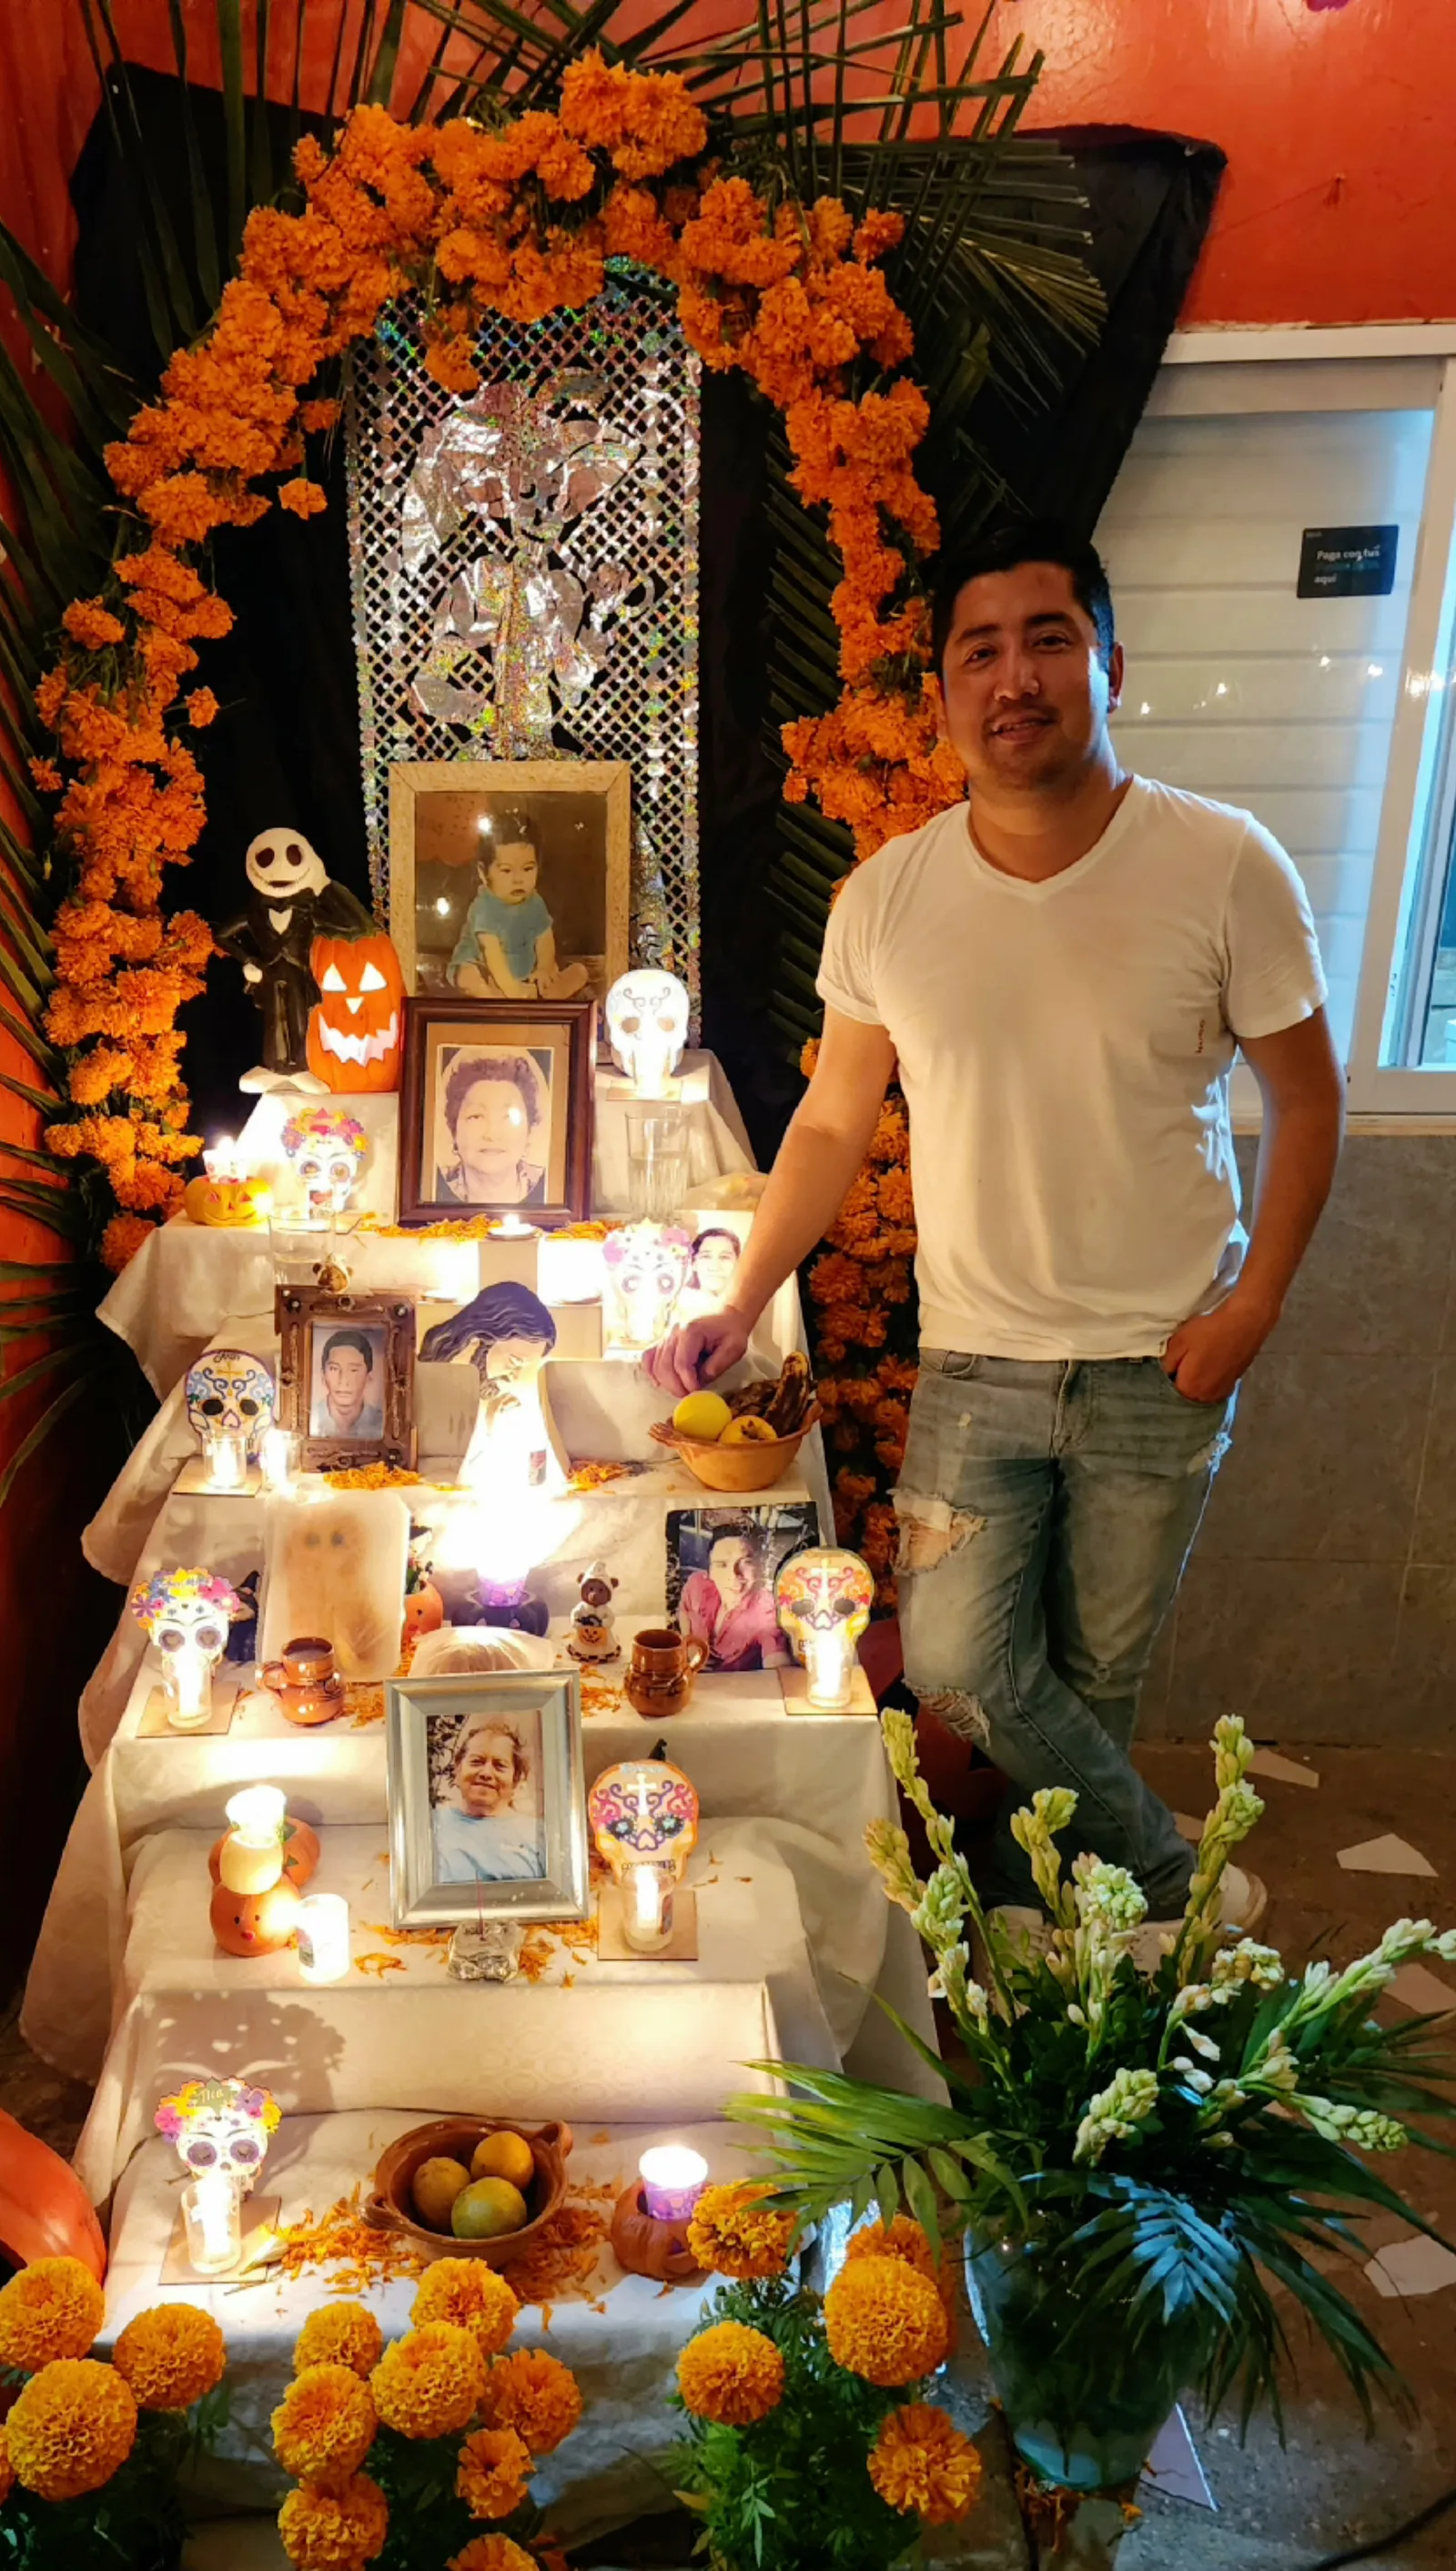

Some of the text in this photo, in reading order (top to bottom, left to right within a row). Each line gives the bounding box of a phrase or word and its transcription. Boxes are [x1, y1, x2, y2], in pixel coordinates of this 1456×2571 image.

[1317, 548, 1380, 562] Paga con tus
[1314, 572, 1337, 585] aquí
